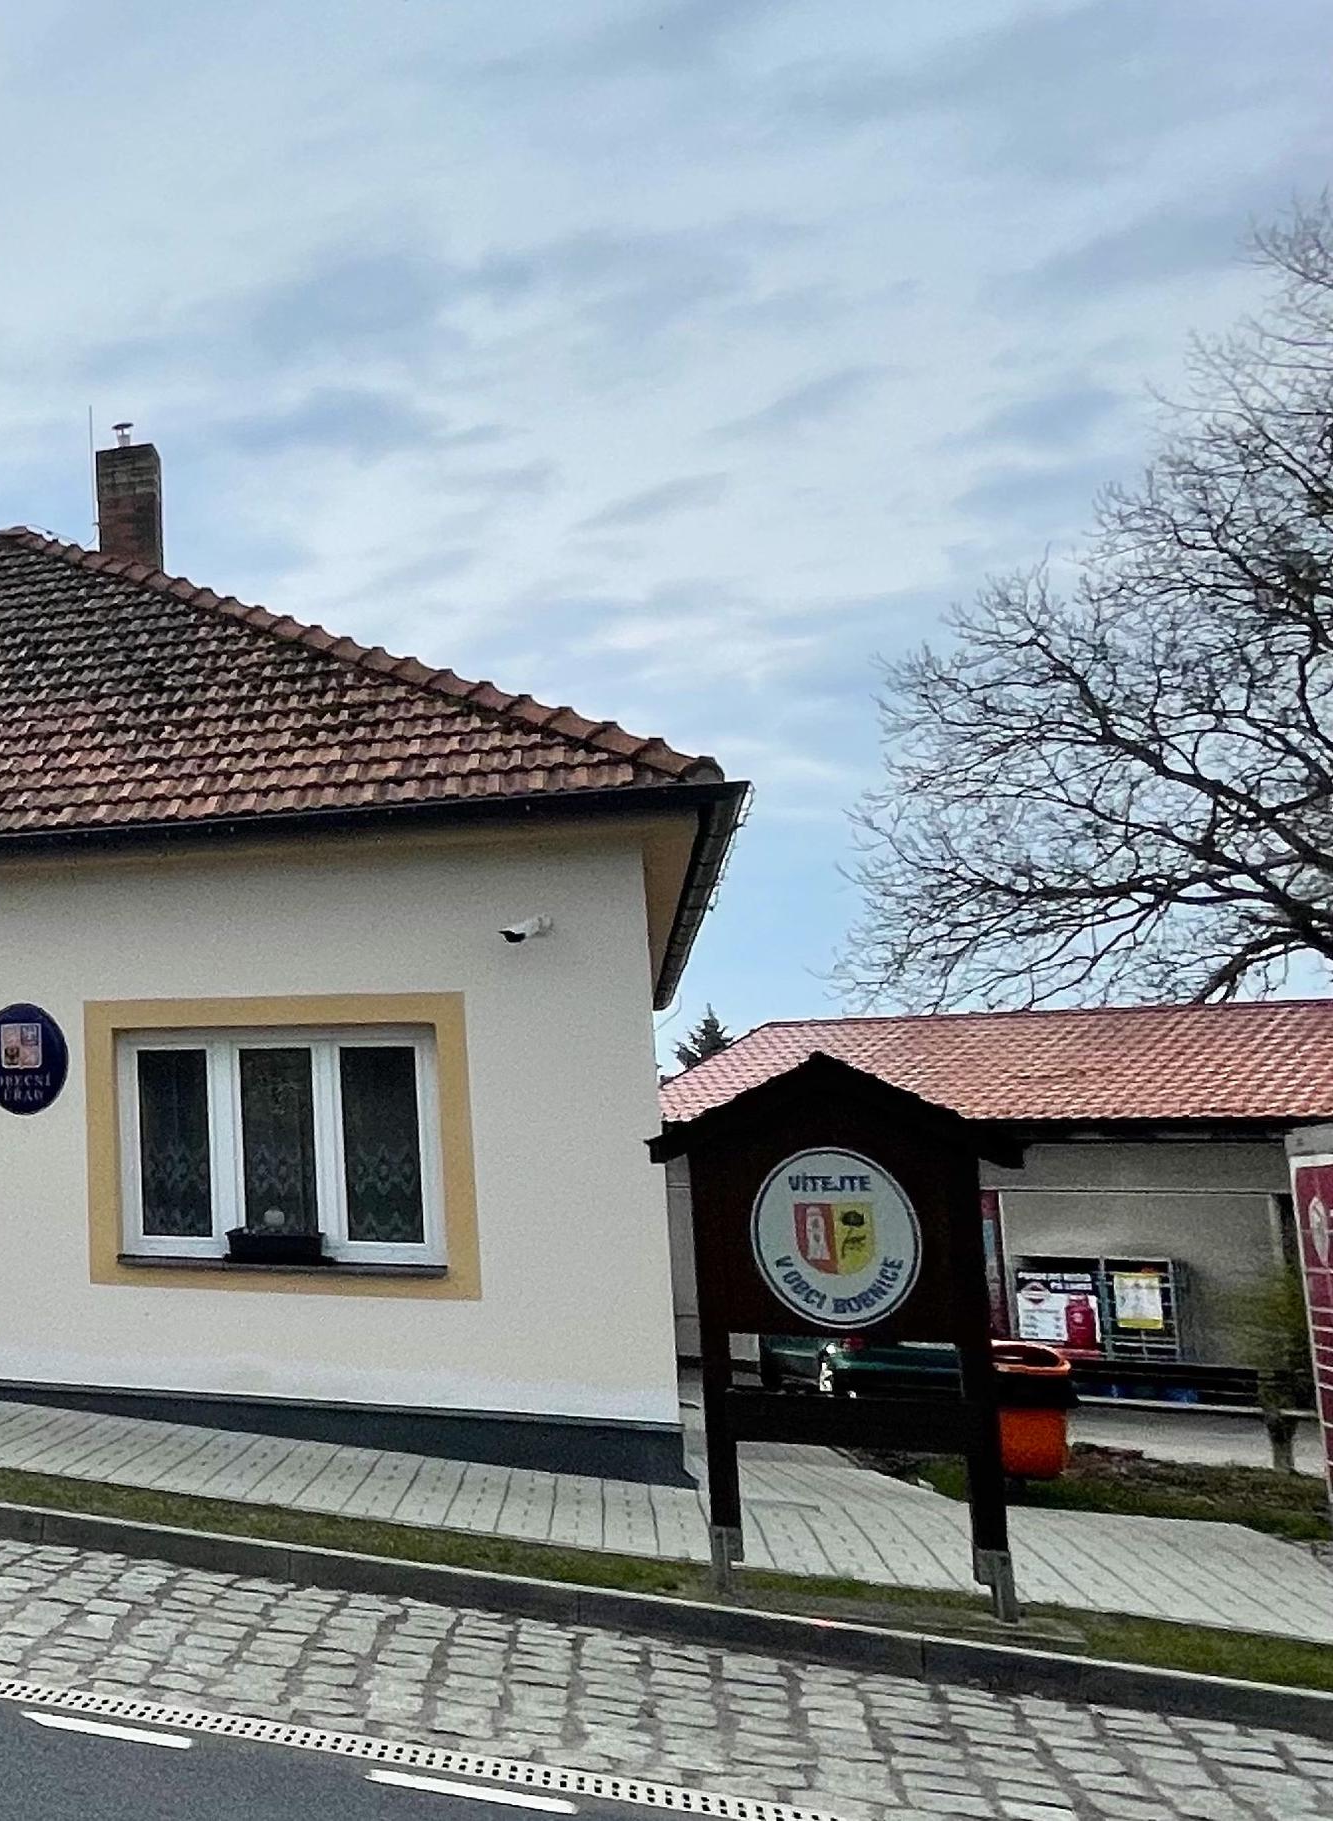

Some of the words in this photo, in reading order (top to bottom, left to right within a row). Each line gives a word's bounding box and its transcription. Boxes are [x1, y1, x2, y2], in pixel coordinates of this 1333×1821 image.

[788, 1173, 872, 1192] VÍTEJTE
[775, 1255, 794, 1269] V
[783, 1270, 827, 1309] OBCI
[832, 1256, 904, 1314] BOBNICE
